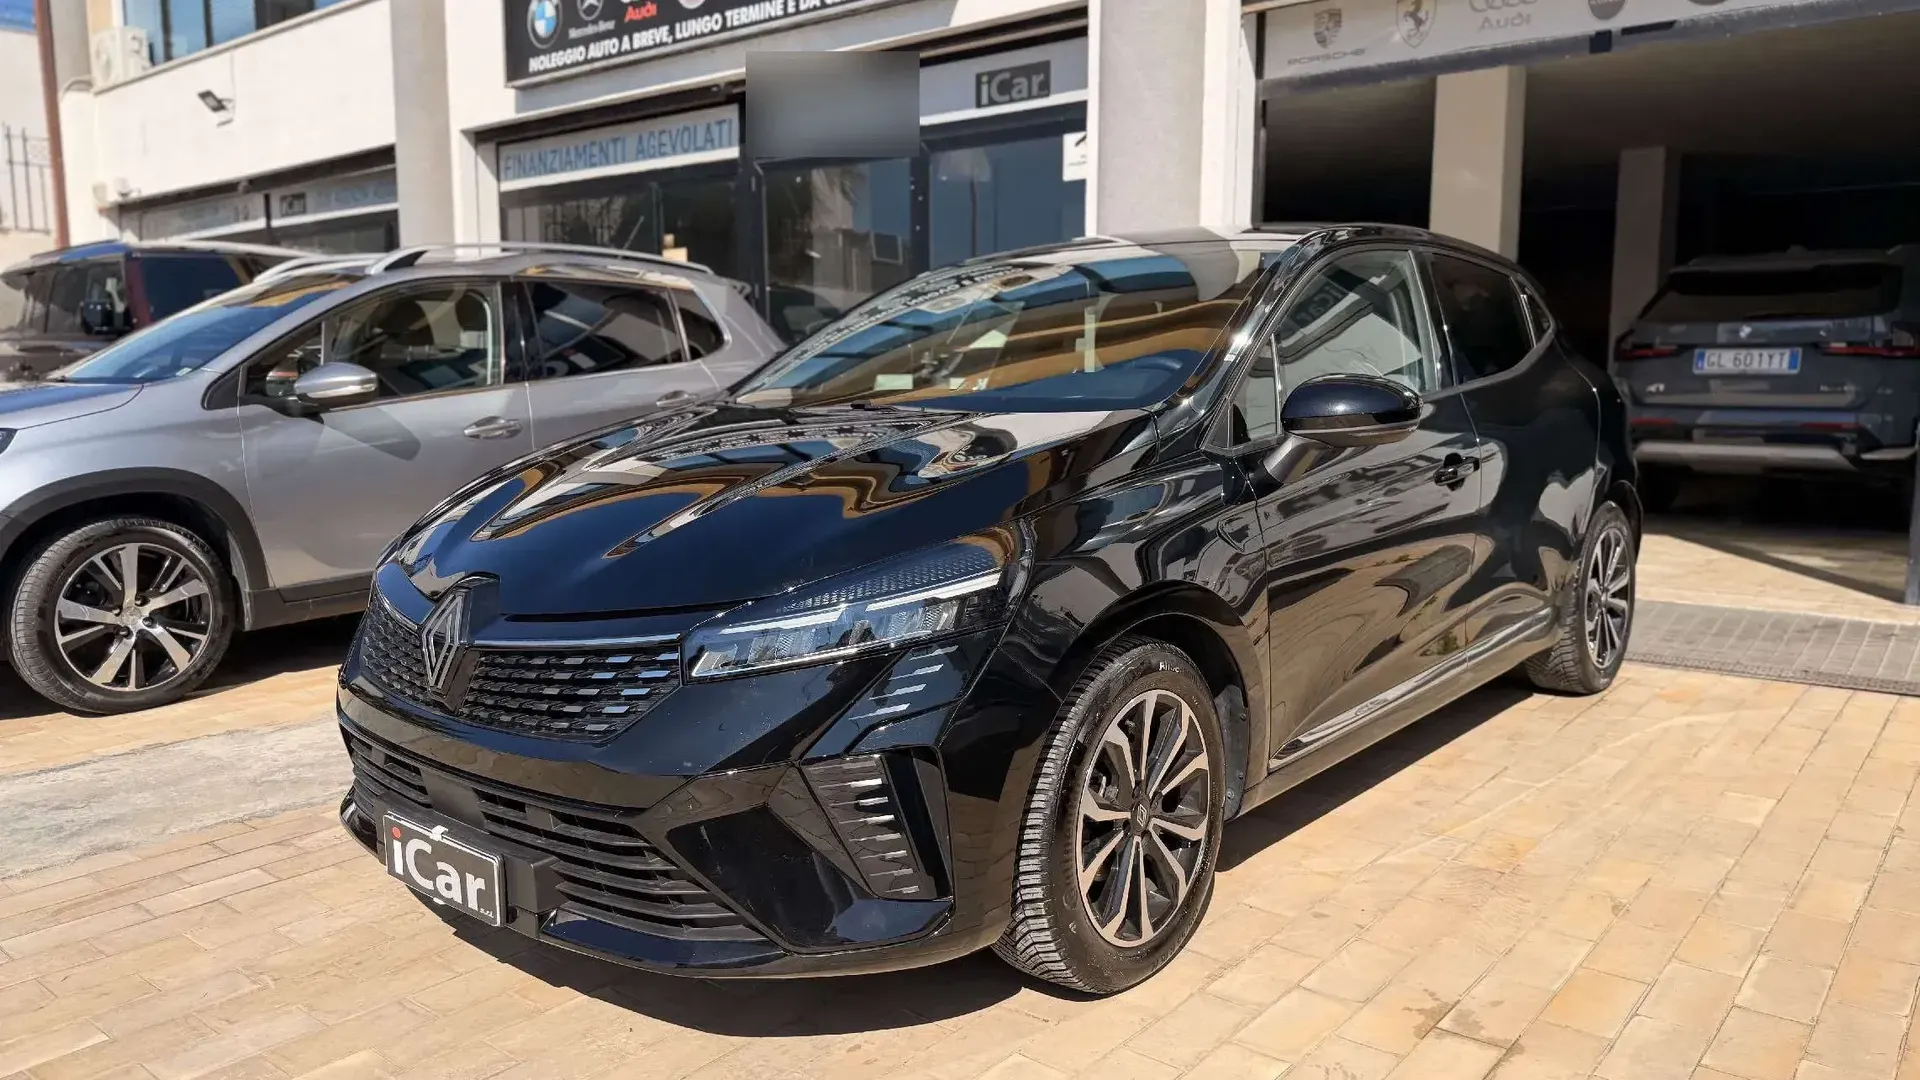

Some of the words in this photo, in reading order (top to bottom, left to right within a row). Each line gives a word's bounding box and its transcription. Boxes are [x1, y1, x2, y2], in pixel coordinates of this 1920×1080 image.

[624, 3, 657, 22] Audi
[1477, 12, 1531, 33] Audi
[529, 47, 586, 73] NOLEGGIO
[588, 40, 618, 60] AUTO
[620, 34, 631, 53] A
[632, 25, 673, 49] BREVE,
[675, 12, 723, 39] LUNGO
[725, 2, 785, 28] TERMINE
[787, 0, 796, 14] E
[1287, 48, 1366, 66] PORSCHE
[980, 71, 1045, 106] iCar
[503, 136, 627, 180] FINANZIAMENTI
[635, 118, 733, 159] AGEVOLATI
[1706, 352, 1725, 368] GL
[1732, 351, 1786, 368] 601YT
[392, 826, 486, 911] iCar
